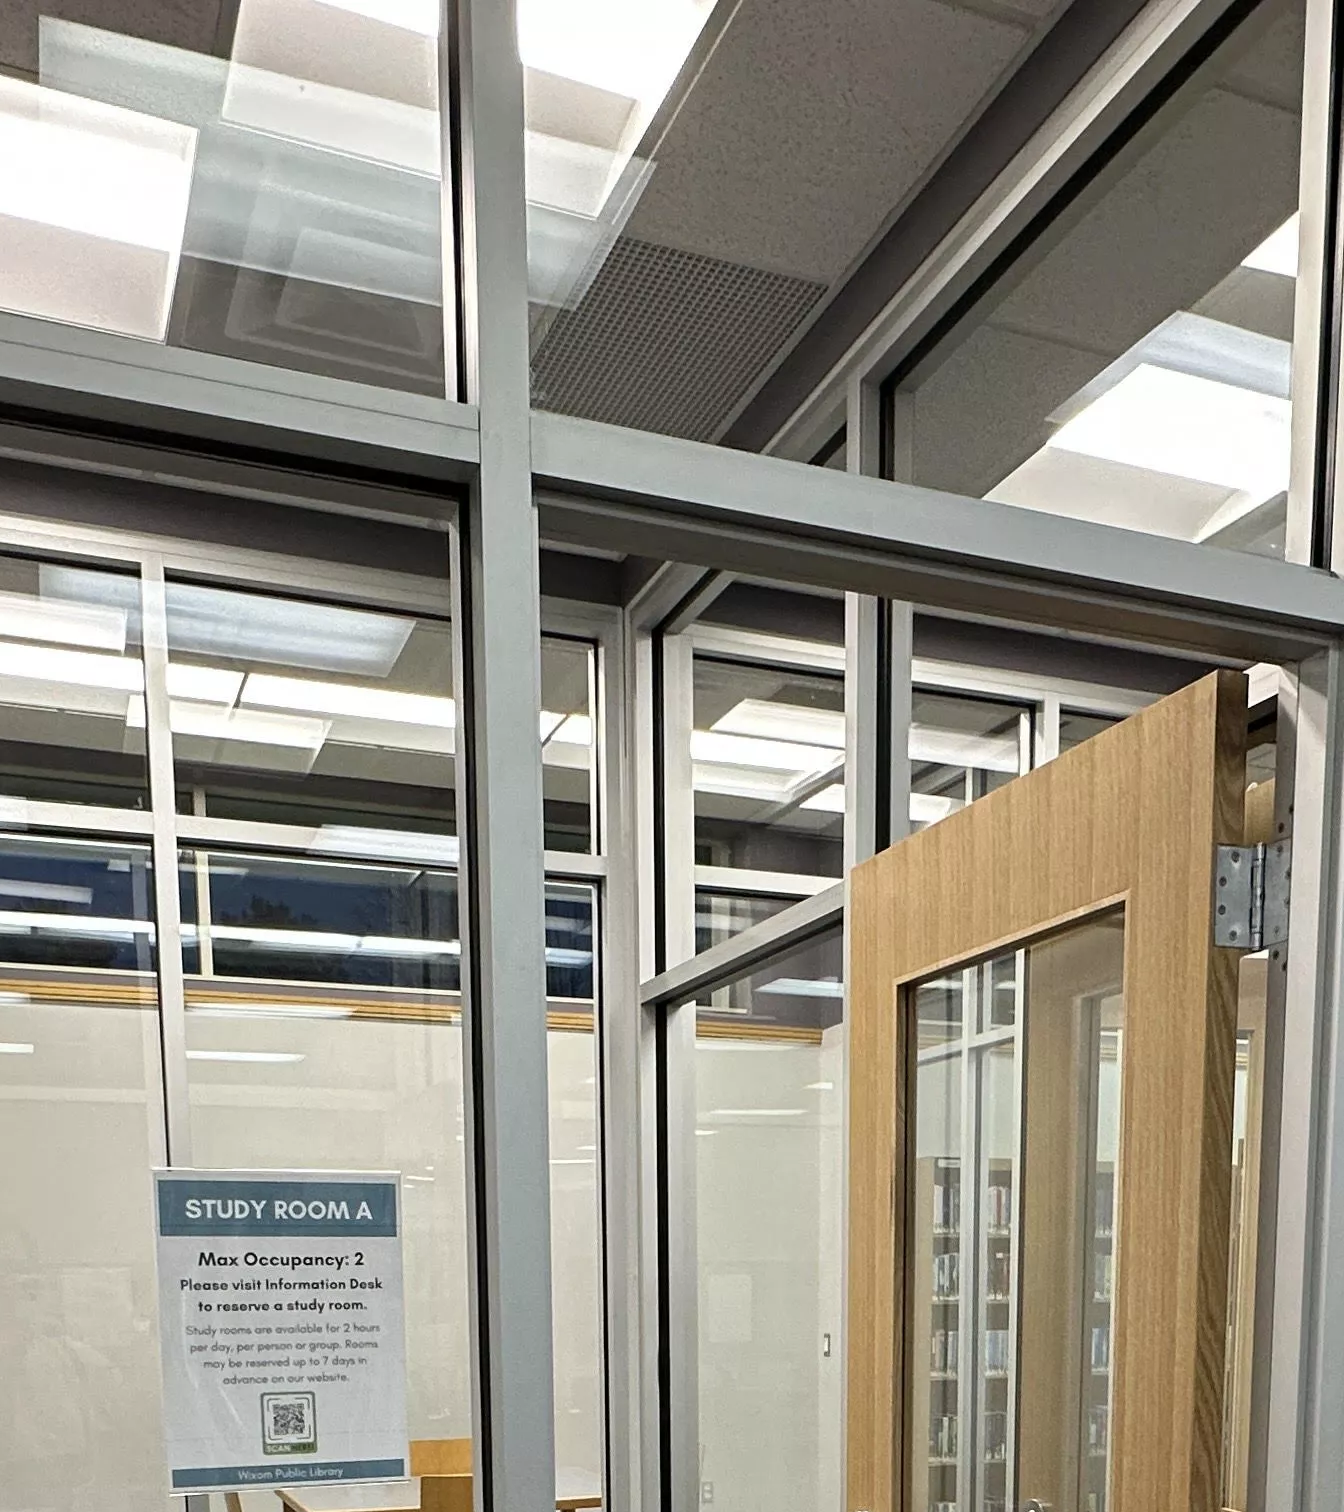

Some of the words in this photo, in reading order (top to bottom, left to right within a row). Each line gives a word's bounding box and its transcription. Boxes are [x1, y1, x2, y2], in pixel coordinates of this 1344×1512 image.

[185, 1199, 266, 1219] STUDY
[274, 1200, 350, 1220] ROOM
[356, 1201, 373, 1220] A
[198, 1252, 239, 1266] Max
[244, 1252, 349, 1269] Occupancy:
[354, 1252, 364, 1265] 2
[180, 1279, 228, 1291] Please
[232, 1279, 261, 1290] visit
[266, 1278, 346, 1290] Information
[350, 1278, 383, 1289] Desk
[198, 1301, 212, 1311] to
[217, 1301, 269, 1311] reserve
[274, 1302, 282, 1310] a
[287, 1299, 325, 1313] study
[329, 1300, 367, 1310] room.
[186, 1325, 217, 1337] Study
[275, 1324, 322, 1334] available
[326, 1324, 340, 1333] for
[343, 1324, 351, 1333] 2
[353, 1324, 380, 1332] hours
[190, 1344, 208, 1353] per
[237, 1343, 254, 1352] per
[257, 1343, 293, 1352] person
[295, 1342, 306, 1350] or
[345, 1340, 378, 1349] Rooms
[204, 1361, 226, 1371] may
[228, 1359, 242, 1368] be
[245, 1357, 290, 1367] reserved
[293, 1358, 306, 1368] up
[309, 1357, 320, 1366] to
[323, 1356, 329, 1365] 7
[332, 1356, 355, 1367] days
[358, 1356, 367, 1365] in
[223, 1375, 269, 1385] advance
[272, 1376, 285, 1384] on
[287, 1375, 304, 1383] our
[238, 1469, 272, 1480] Wixom
[275, 1468, 307, 1478] Public
[309, 1466, 344, 1478] Library
